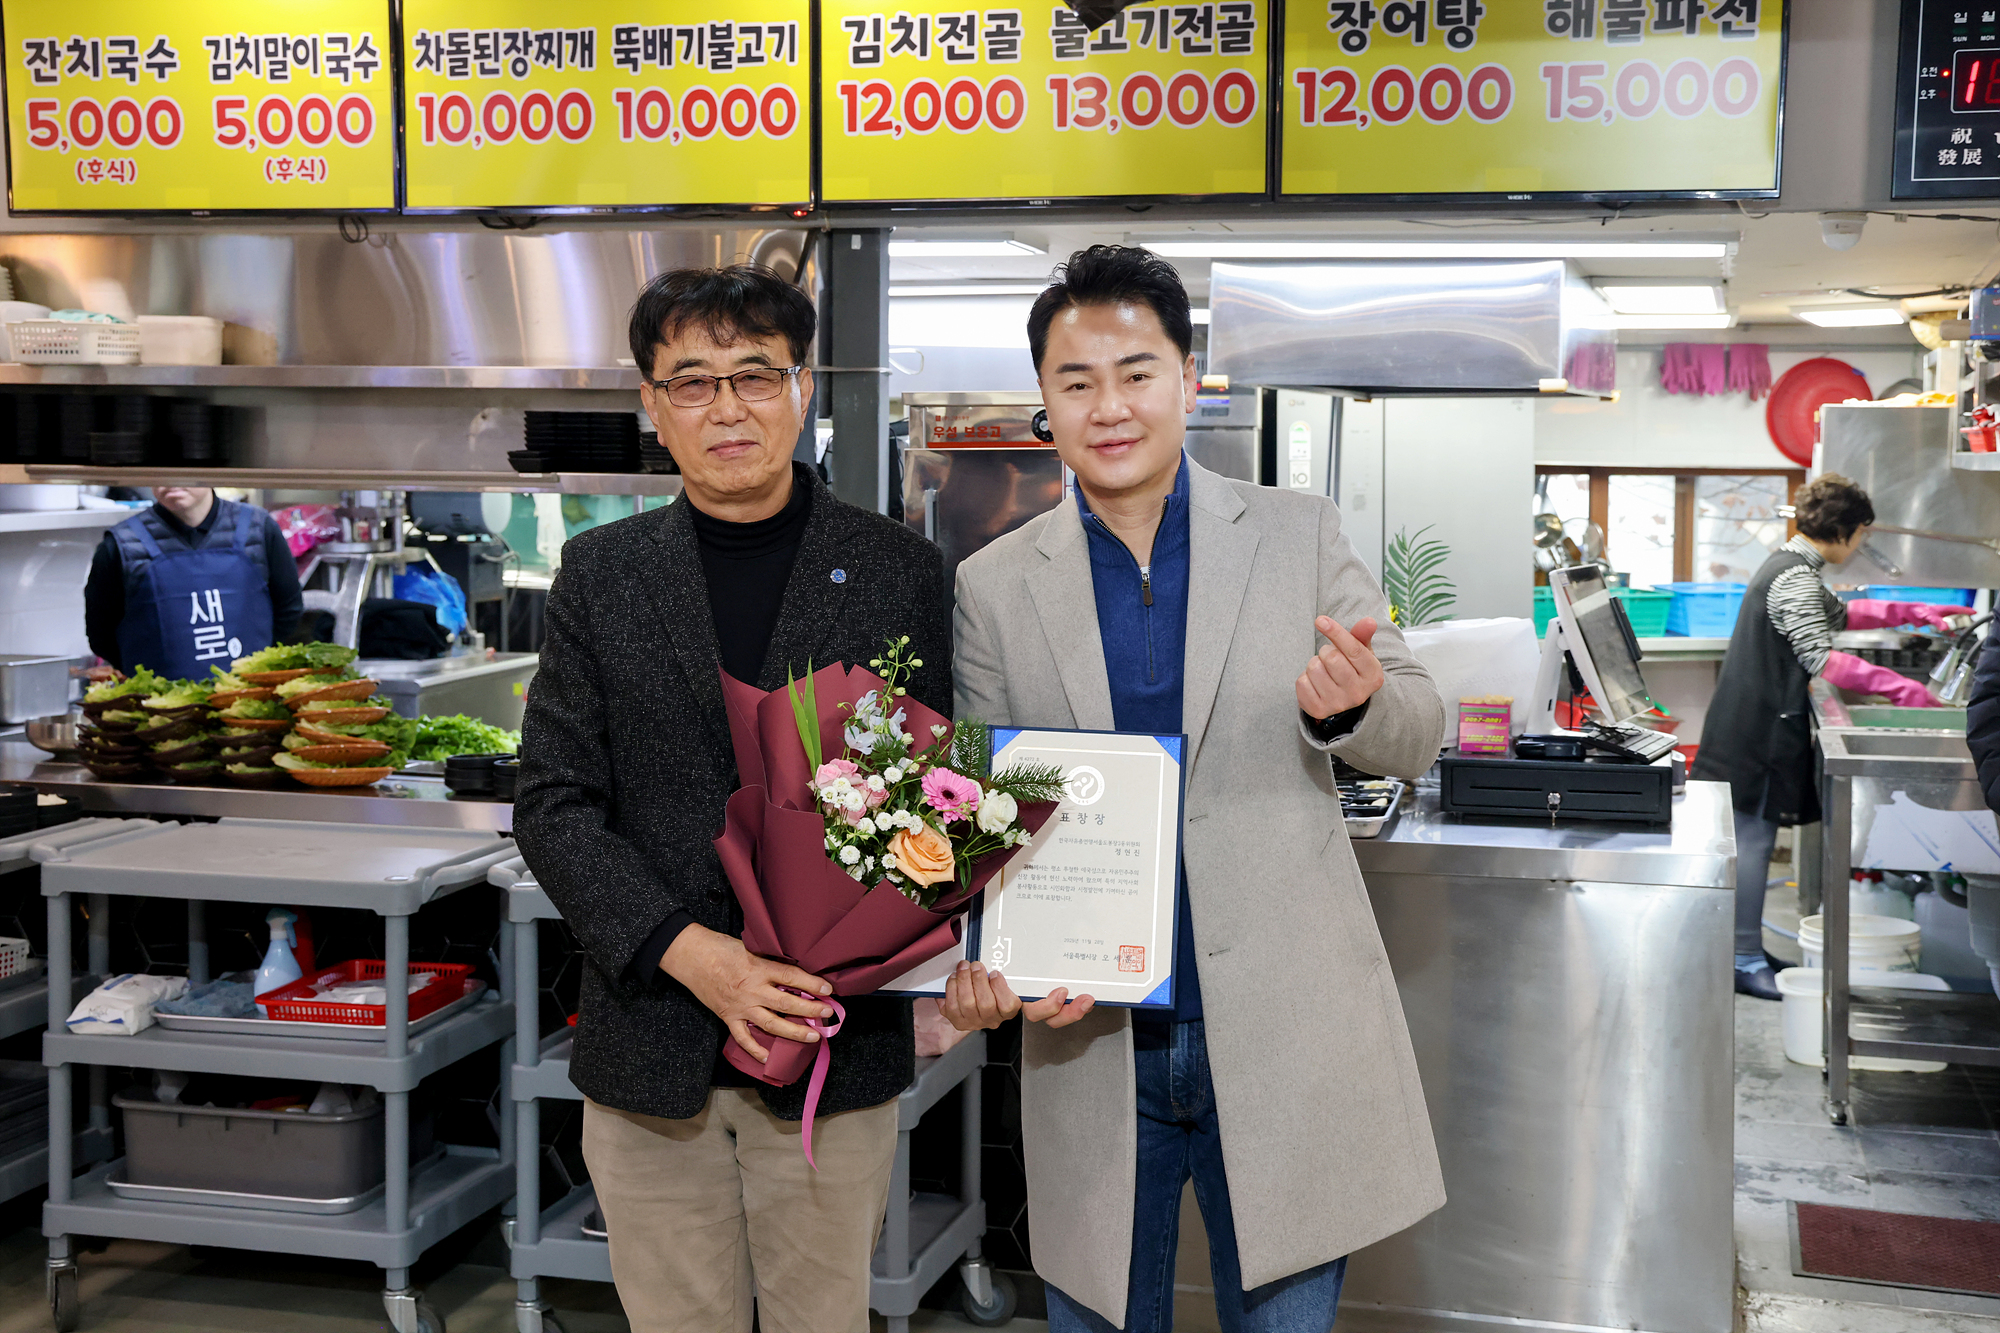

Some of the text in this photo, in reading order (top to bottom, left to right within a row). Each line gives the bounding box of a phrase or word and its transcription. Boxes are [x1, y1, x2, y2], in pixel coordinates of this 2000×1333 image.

[845, 5, 1254, 62] 김치전골 불고기전골
[1330, 0, 1482, 52] 장어탕
[1954, 11, 1995, 23] 일 월
[25, 36, 378, 83] 잔치국수 김치말이국수
[416, 23, 795, 77] 차돌된장찌개 뚝배기불고기
[1920, 67, 1937, 77] 오전
[419, 88, 796, 146] 10,000 10,000
[841, 73, 1255, 136] 12,000 13,000
[1297, 60, 1759, 126] 12,000 15,000
[1919, 89, 1936, 99] 오후
[28, 98, 372, 150] 5,000 5,000
[1950, 128, 1972, 144] 祝
[77, 157, 326, 183] (후식) (후식)
[1938, 148, 1982, 165] 發展
[934, 426, 1001, 438] 우성 보온고
[190, 588, 229, 660] 새로
